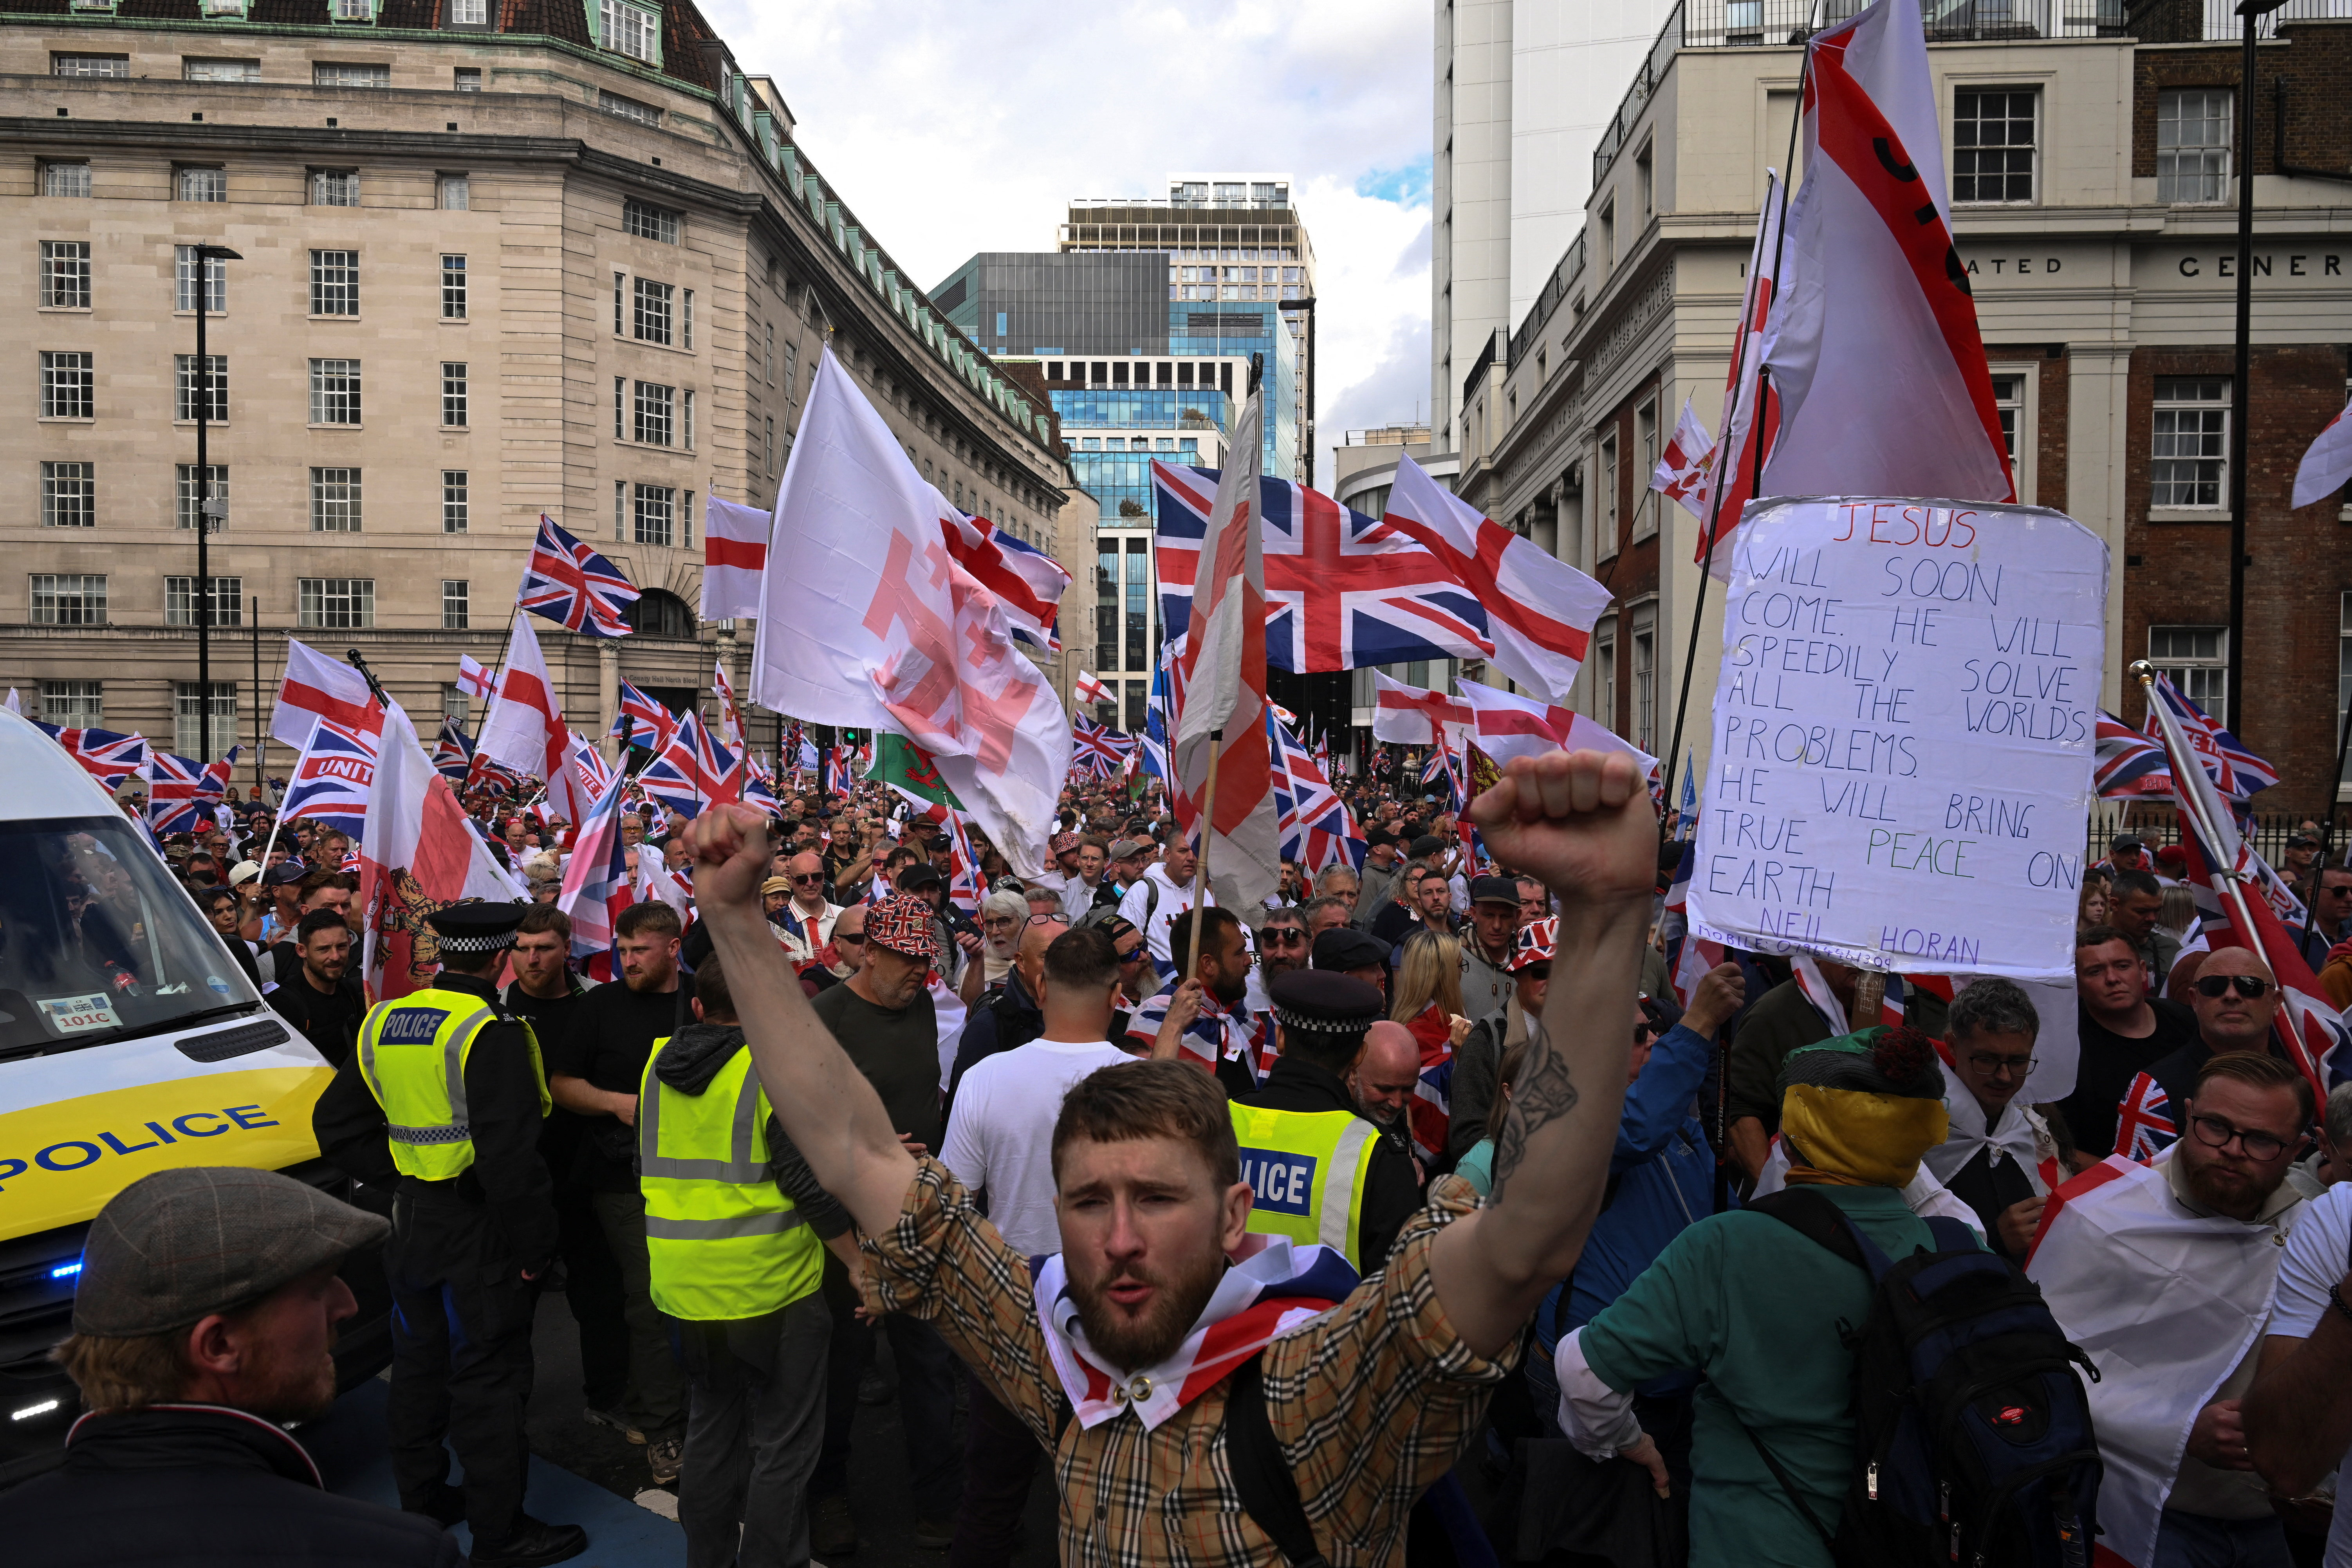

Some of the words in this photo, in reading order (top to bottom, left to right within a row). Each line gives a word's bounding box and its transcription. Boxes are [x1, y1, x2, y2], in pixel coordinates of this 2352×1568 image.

[2179, 255, 2341, 277] GENER
[1588, 365, 1598, 383] THE
[1601, 328, 1629, 370] PRINCESS
[1634, 315, 1642, 333] OF
[1647, 283, 1670, 319] WALES
[1599, 337, 1609, 357] HER
[1614, 307, 1634, 338] ROYAL
[1638, 260, 1673, 311] HIGHNESS
[1505, 455, 1526, 486] GENERAL
[1558, 393, 1580, 430] HOSPI
[1834, 503, 1977, 548] JESUS
[1747, 547, 1827, 588] WILL
[1881, 557, 2002, 606] SOON
[1742, 591, 1844, 637] COME.
[1892, 606, 1941, 646] HE
[1991, 614, 2072, 659] WILL
[629, 675, 650, 683] County
[1732, 634, 1899, 682] SPEEDILY
[1962, 659, 2078, 703] SOLVE
[448, 716, 461, 725] BRITS
[1728, 671, 1794, 711] ALL
[1855, 684, 1914, 724] THE
[1967, 696, 2086, 742] WORLD'S
[317, 760, 374, 782] UNIT
[1725, 715, 1917, 779] PROBLEMS.
[577, 765, 598, 790] NITE
[1719, 764, 1769, 805] HE
[1821, 777, 1897, 822] WILL
[1946, 794, 2036, 839] BRING
[1715, 809, 1807, 855] TRUE
[1868, 828, 1978, 878] PEACE
[2028, 851, 2077, 890] ON
[1709, 855, 1835, 909] EARTH
[1760, 907, 1831, 944] NEIL
[1881, 925, 1980, 965] HORAN
[59, 1012, 110, 1027] 101C
[382, 1014, 442, 1038] POLICE
[1239, 1158, 1307, 1204] LICE
